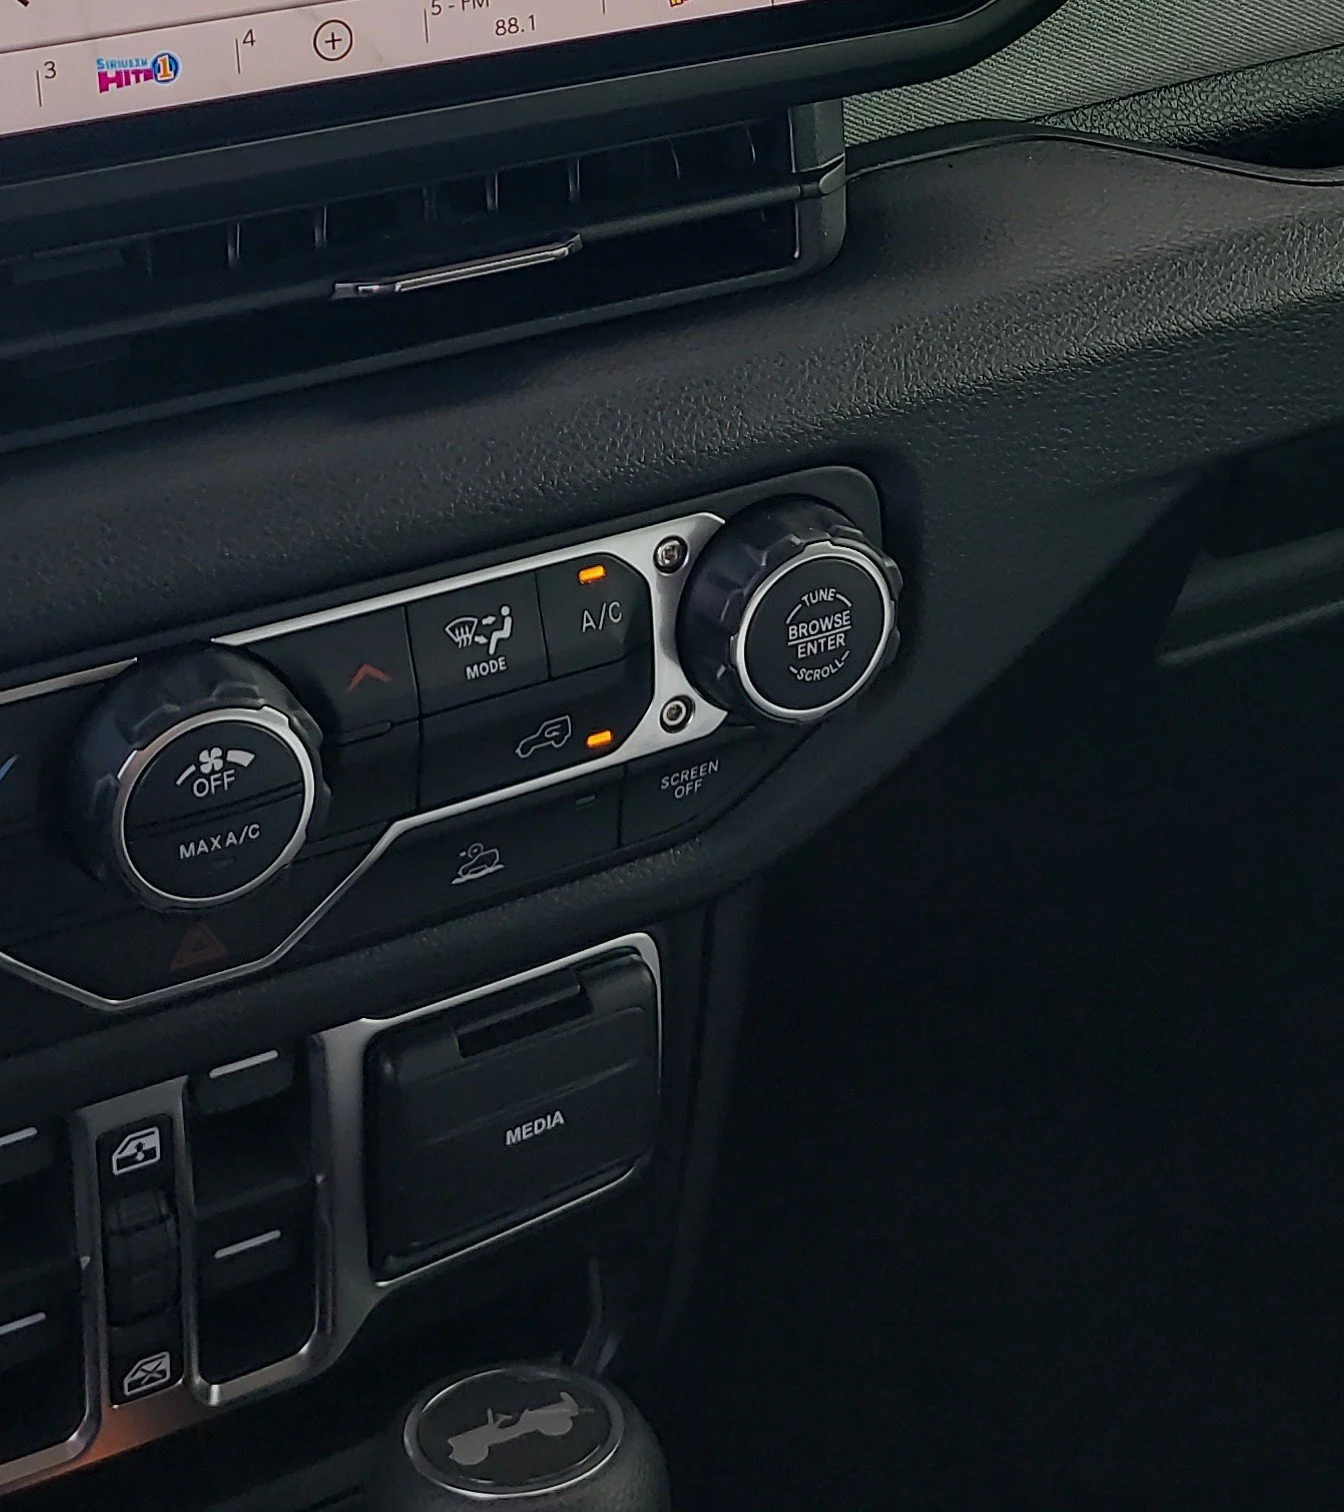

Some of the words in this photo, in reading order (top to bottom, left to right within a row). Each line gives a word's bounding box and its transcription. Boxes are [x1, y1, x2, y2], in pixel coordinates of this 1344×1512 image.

[243, 29, 255, 48] 4
[495, 15, 537, 37] 88.1
[43, 60, 56, 79] 3
[800, 587, 837, 609] TUNE
[580, 602, 623, 633] A/C
[787, 610, 852, 641] BROWSE
[796, 632, 846, 659] ENTER
[466, 655, 507, 681] MODE
[796, 654, 845, 683] SCROLL
[192, 769, 236, 798] OFF
[661, 759, 720, 790] SCREEN
[674, 779, 703, 800] OFF
[178, 834, 222, 861] MAX
[225, 823, 262, 851] A/C
[504, 1109, 566, 1147] MEDIA
